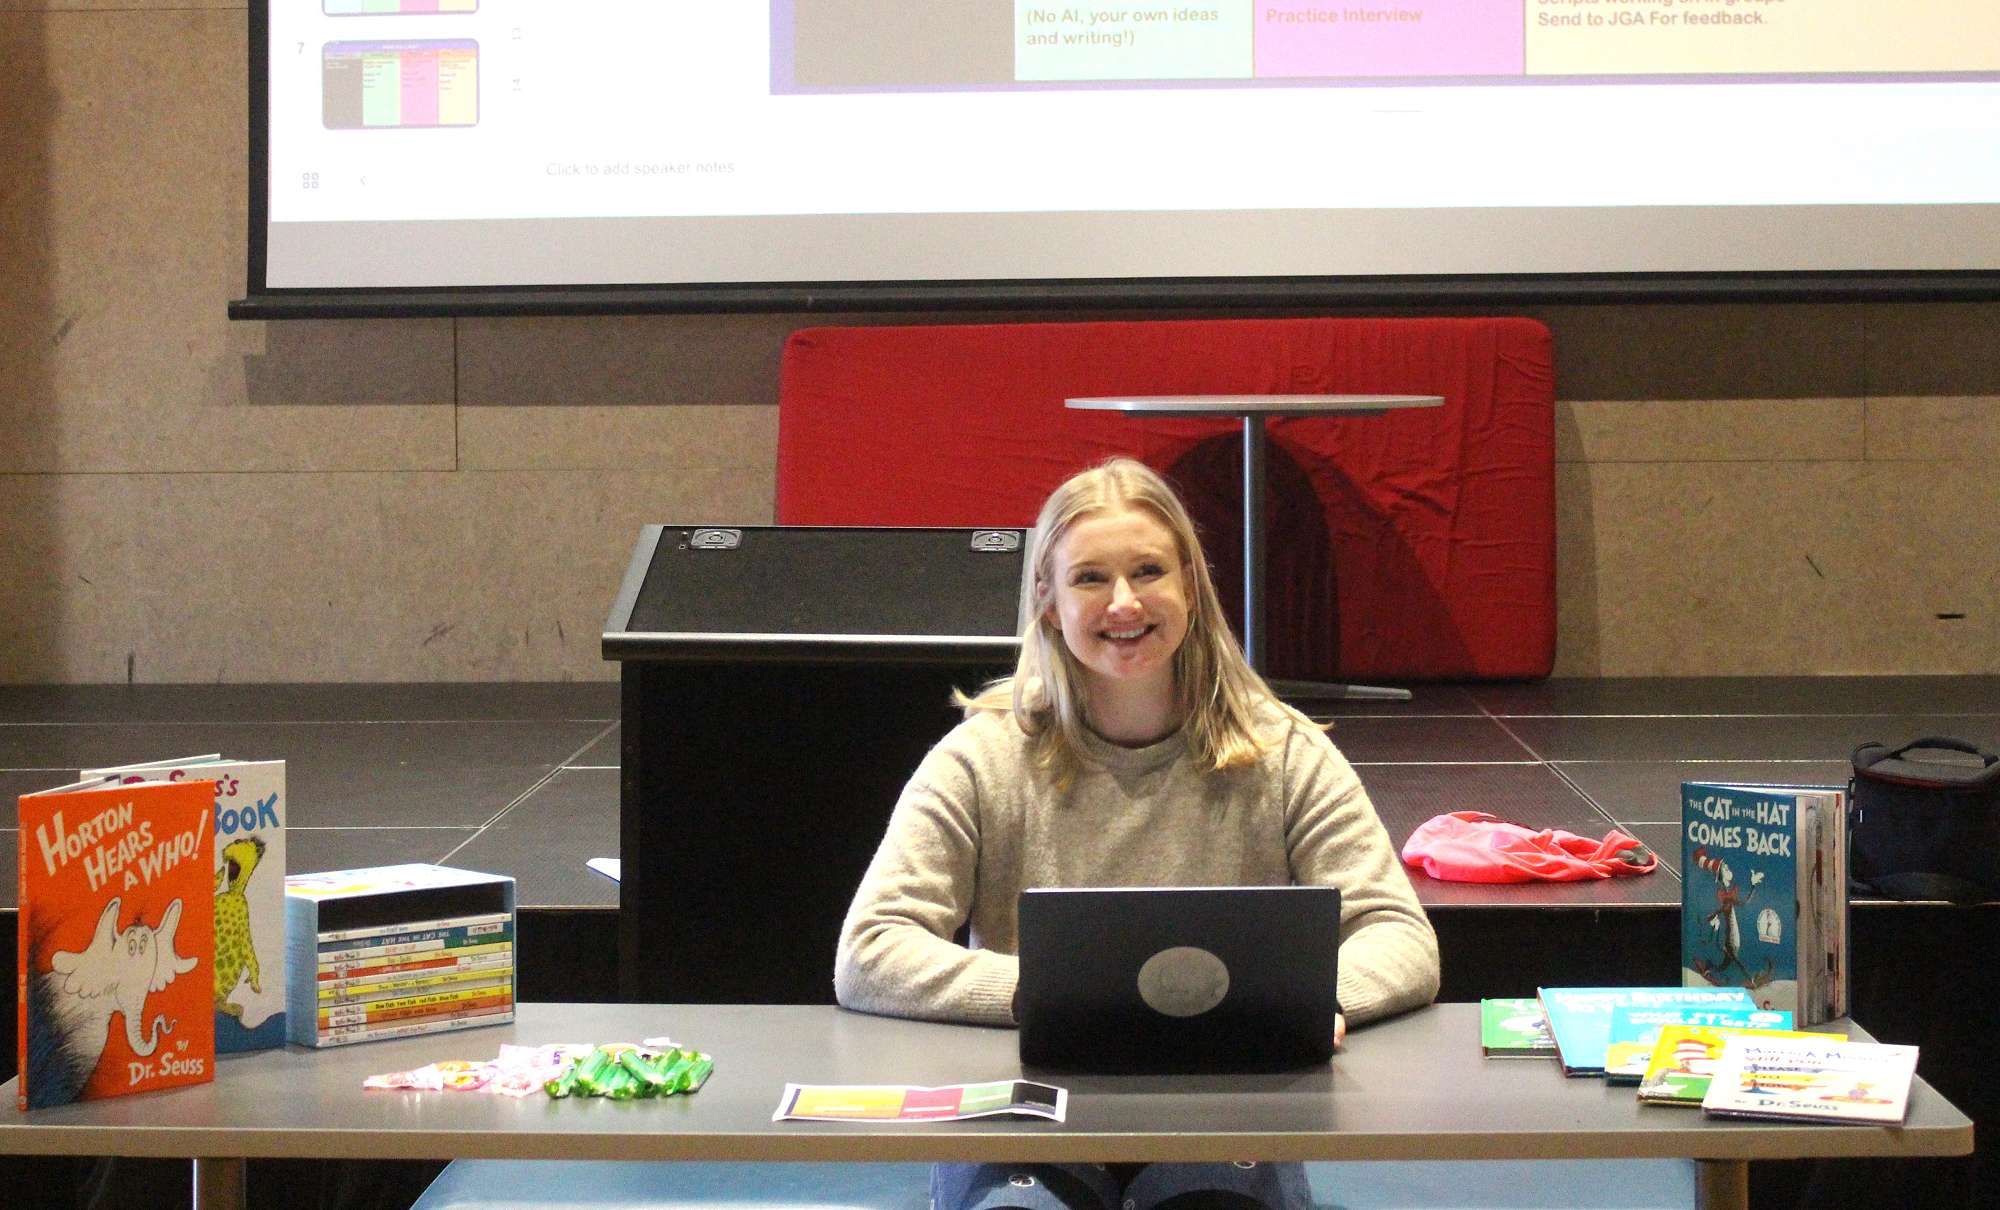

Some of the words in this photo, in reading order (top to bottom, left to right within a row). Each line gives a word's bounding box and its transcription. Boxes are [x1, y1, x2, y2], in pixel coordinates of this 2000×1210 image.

[1027, 10, 1056, 24] (No
[1090, 11, 1128, 26] your
[1133, 11, 1168, 22] own
[1173, 8, 1219, 22] ideas
[1265, 8, 1338, 22] Practice
[1344, 7, 1424, 22] Interview
[1537, 12, 1582, 26] Send
[1587, 12, 1604, 26] to
[1608, 11, 1645, 26] JGA
[1650, 11, 1679, 25] For
[1683, 10, 1768, 25] feedback.
[296, 42, 305, 55] 7
[1026, 32, 1058, 45] and
[1063, 31, 1135, 47] writing!)
[545, 161, 581, 176] Click
[586, 162, 599, 175] to
[603, 161, 630, 175] add
[634, 161, 692, 177] speaker
[696, 160, 736, 174] notes
[1689, 799, 1703, 811] THE
[1703, 796, 1733, 821] CAT
[1732, 807, 1741, 817] IN
[1742, 808, 1757, 819] THE
[1756, 801, 1790, 826] HAT
[35, 801, 134, 877] HORTON
[123, 870, 140, 892] A
[138, 809, 209, 887] WHO!
[1687, 820, 1742, 848] COMES
[1745, 826, 1791, 858] BACK
[82, 821, 155, 892] HEARS
[128, 1062, 157, 1087] Dr.
[159, 1054, 205, 1078] Seuss
